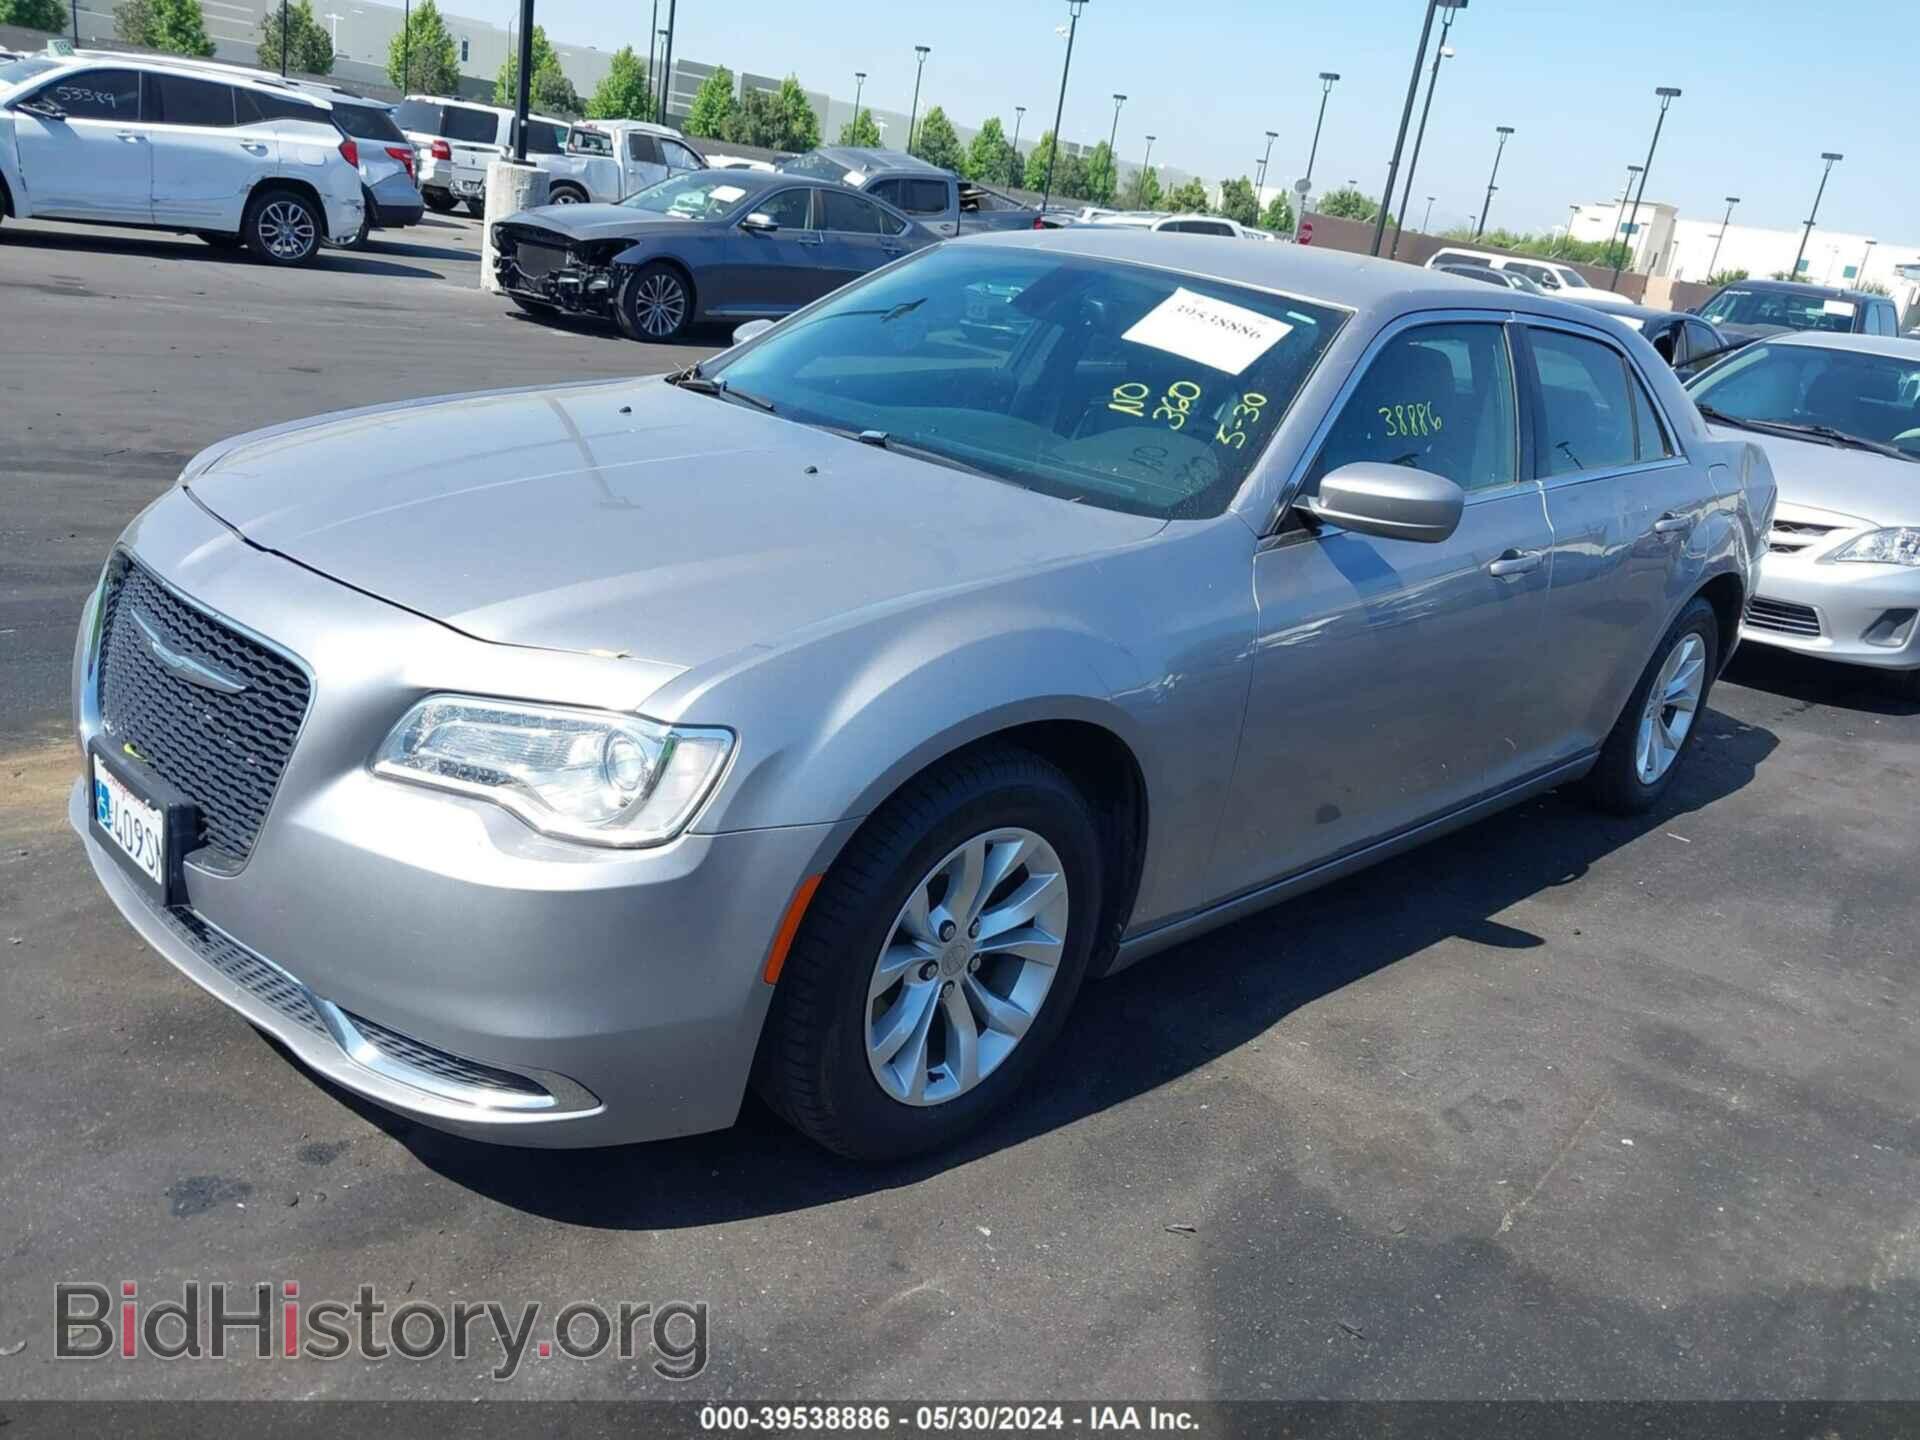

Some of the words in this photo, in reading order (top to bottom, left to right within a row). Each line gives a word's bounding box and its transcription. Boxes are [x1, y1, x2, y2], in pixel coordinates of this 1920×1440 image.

[56, 86, 117, 109] 53389
[1152, 381, 1201, 430] 360
[1216, 392, 1268, 449] 5-30
[1378, 401, 1442, 436] 38886
